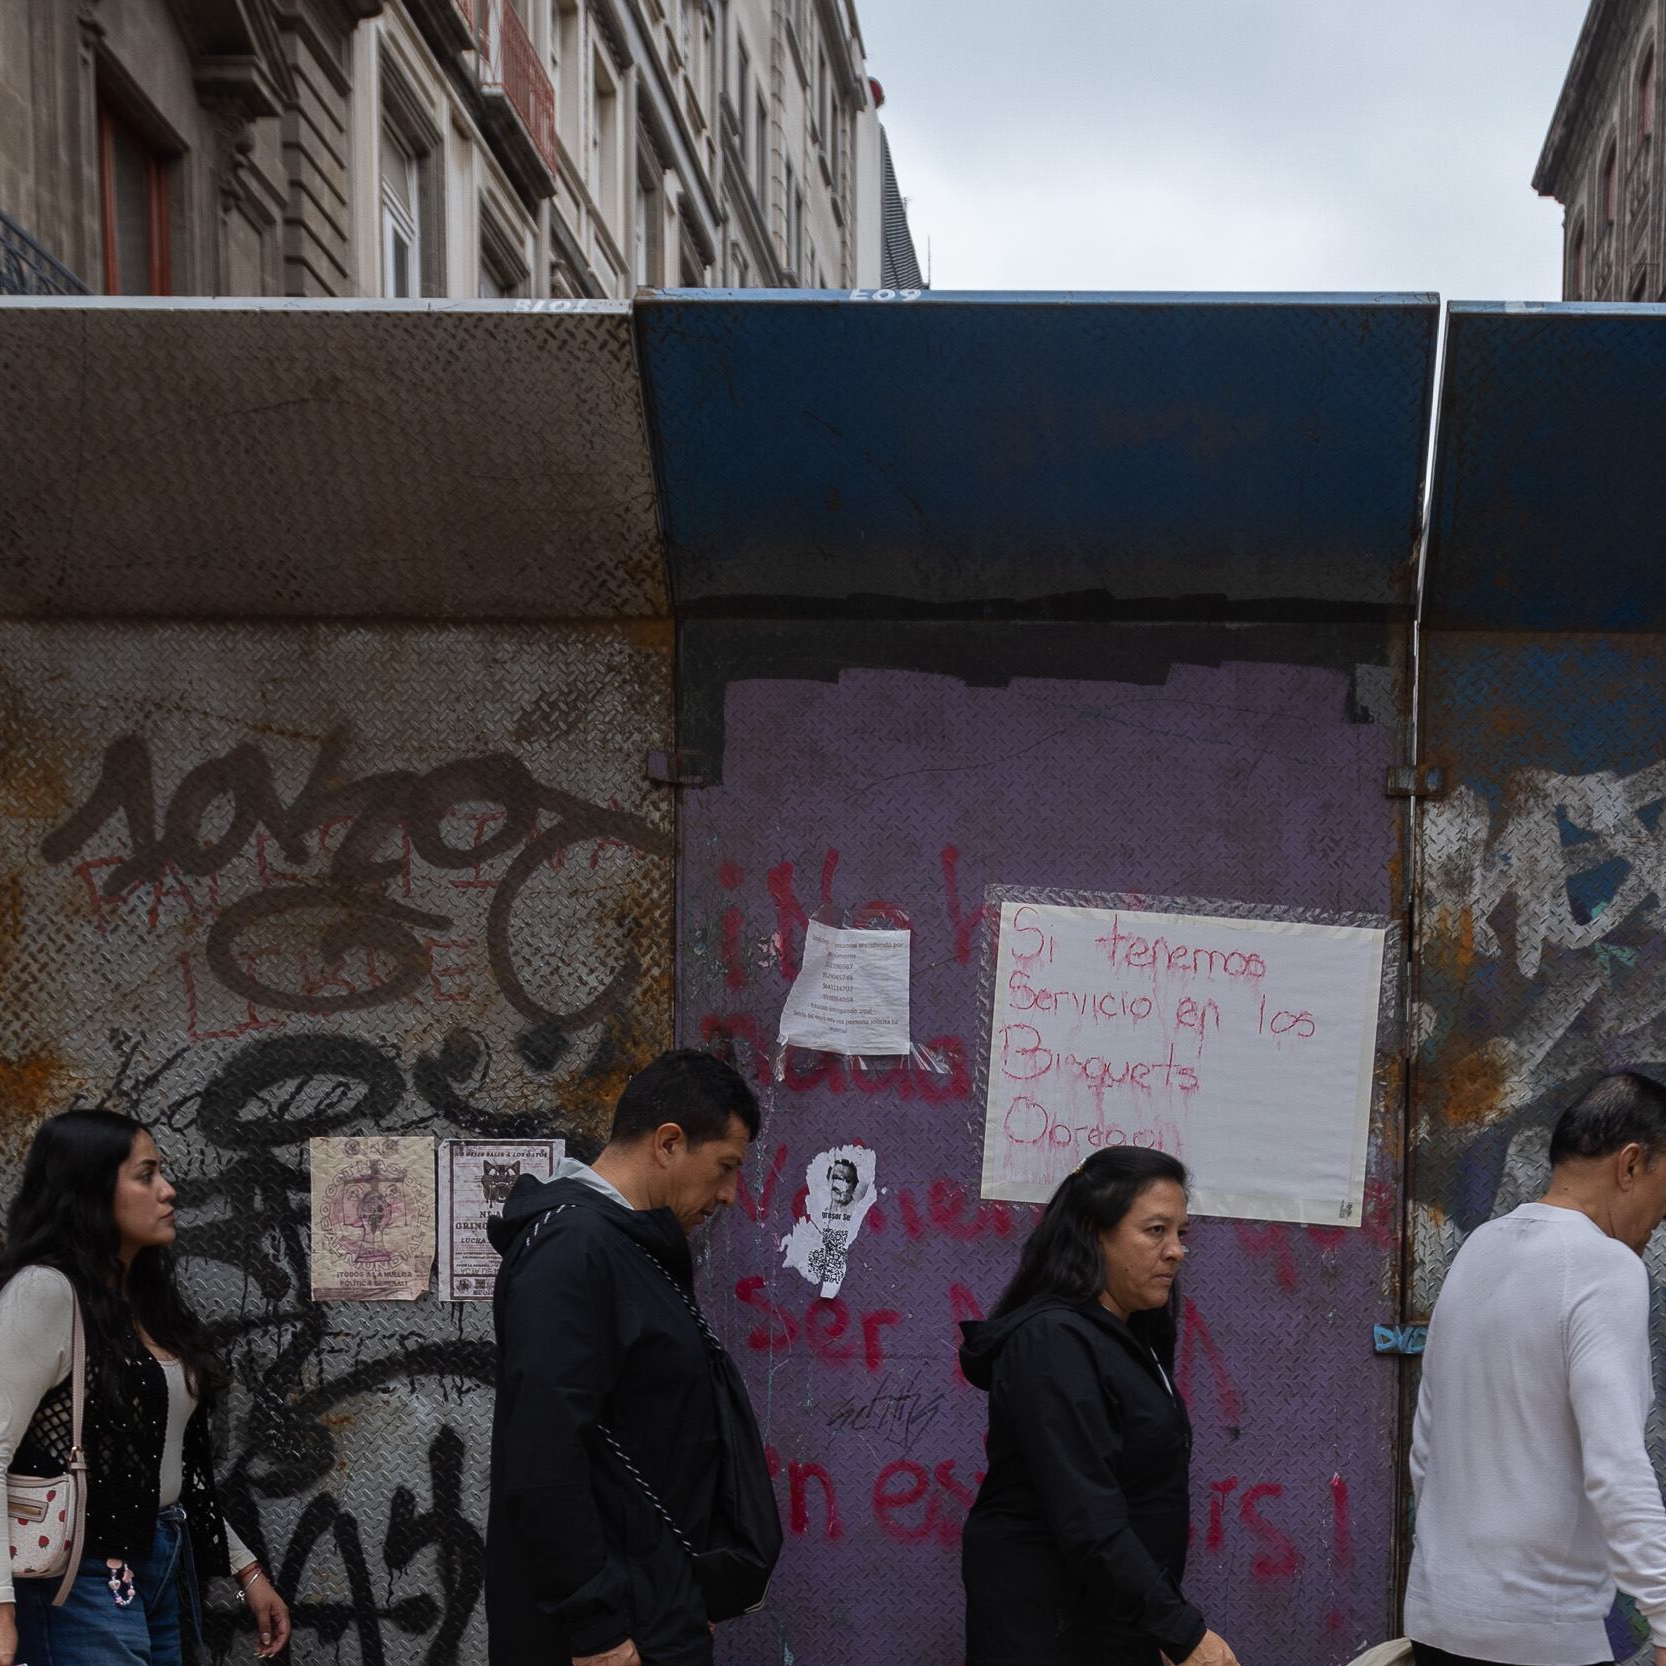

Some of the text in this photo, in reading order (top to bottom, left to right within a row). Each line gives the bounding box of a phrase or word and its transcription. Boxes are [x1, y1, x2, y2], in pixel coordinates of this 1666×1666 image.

[1011, 905, 1266, 979] Si tenemos
[1009, 970, 1317, 1038] Servicio en los
[735, 1275, 903, 1370] Ser
